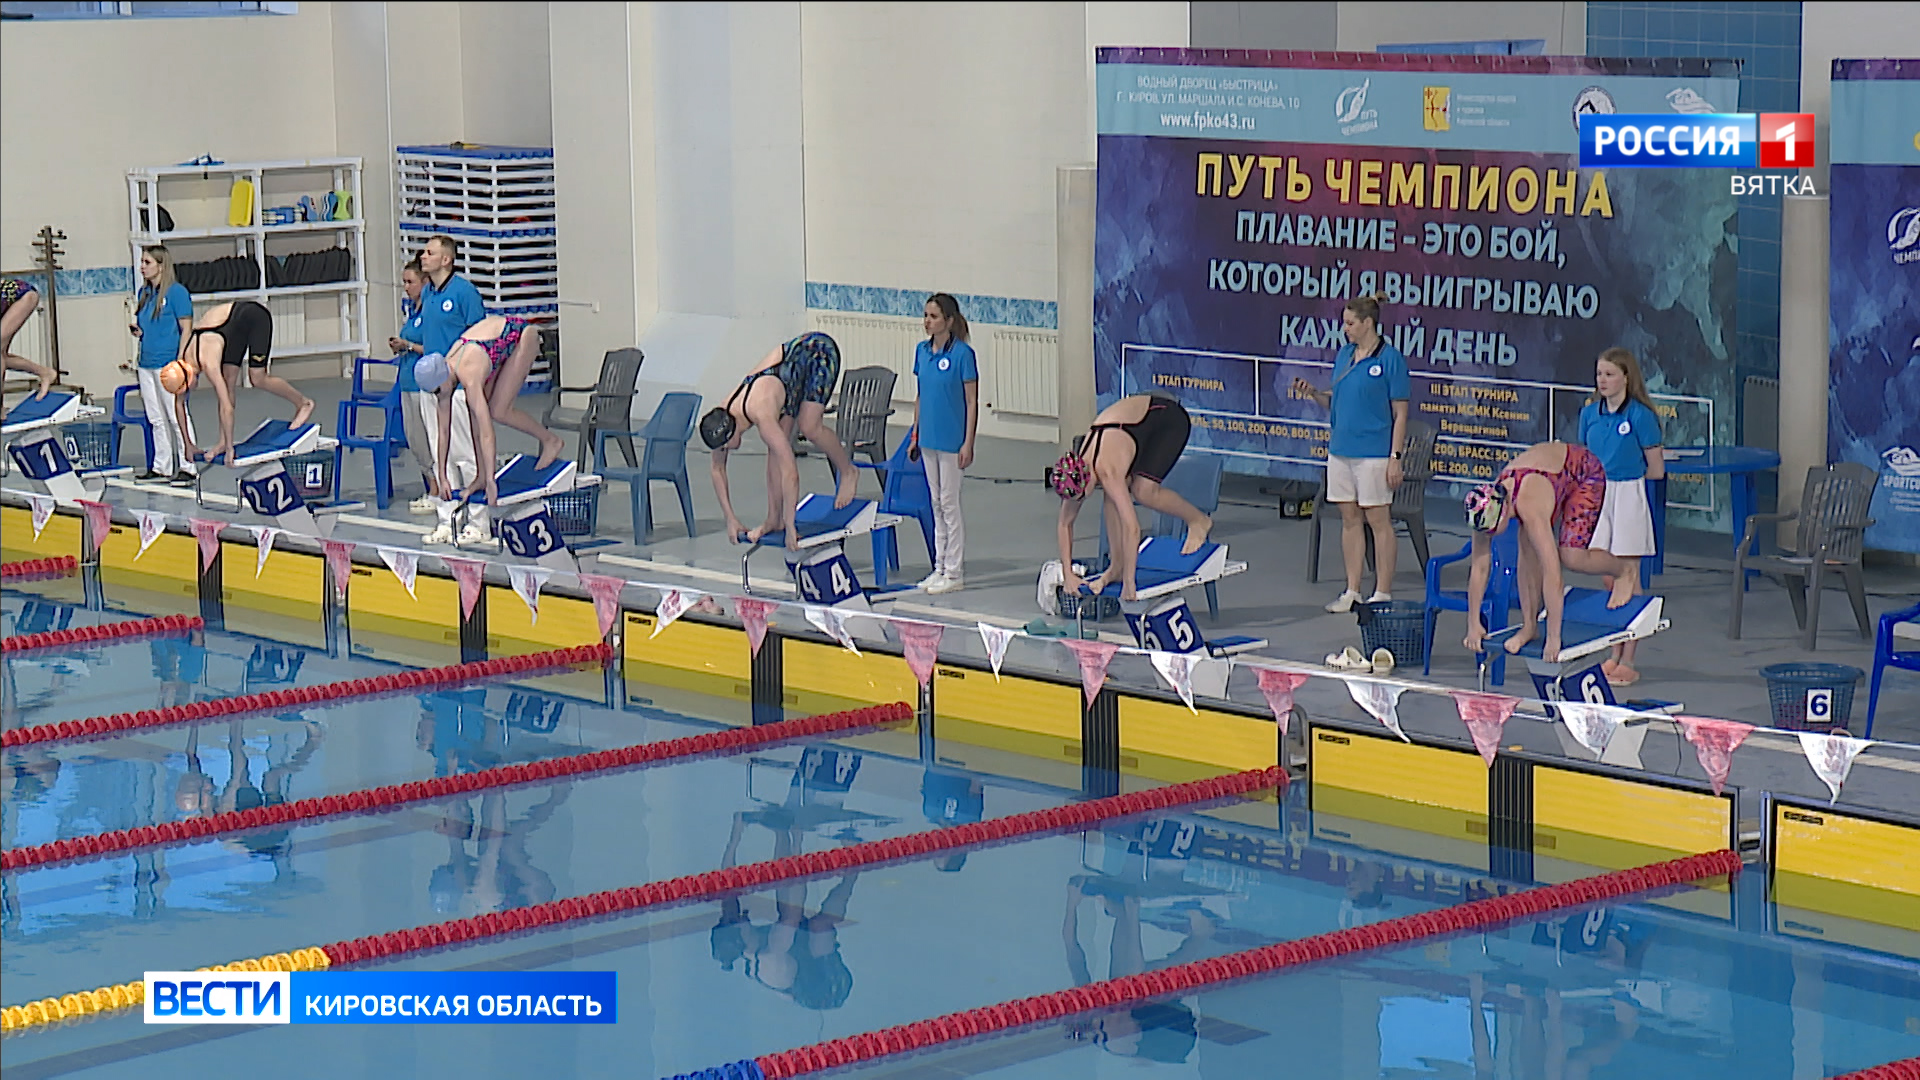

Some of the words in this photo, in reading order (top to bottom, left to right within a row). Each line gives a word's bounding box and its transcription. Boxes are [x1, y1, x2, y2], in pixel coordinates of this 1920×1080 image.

[1137, 75, 1177, 89] ВОДНЫЙ
[1179, 77, 1217, 90] ДВОРЕЦ
[1178, 93, 1227, 106] МАРШАЛА
[1248, 96, 1286, 109] КОНЕВА,
[1288, 97, 1300, 109] 10
[1160, 111, 1256, 131] www.fpko43.ru
[1196, 152, 1312, 201] ПУТЬ
[1324, 158, 1614, 218] ЧЕМПИОНА
[1236, 210, 1397, 252] ПЛАВАНИЕ
[1423, 222, 1482, 258] ЭТО
[1490, 220, 1567, 269] БОЙ,
[1208, 259, 1351, 300] КОТОРЫЙ
[1359, 270, 1378, 298] Я
[1385, 271, 1599, 319] ВЫИГРЫВАЮ
[1281, 315, 1425, 358] КАЖЫЙ
[1430, 327, 1518, 366] ДЕНЬ
[1157, 374, 1181, 388] ЭТАП
[1182, 376, 1225, 392] ТУРНИРА
[1430, 383, 1441, 395] III
[1442, 385, 1469, 398] ЭТАП
[1470, 387, 1519, 402] ТУРНИРА
[1420, 403, 1456, 414] памяти
[1457, 404, 1491, 418] МСМК
[1492, 407, 1530, 421] Ксении
[1212, 419, 1226, 432] 50,
[1227, 421, 1246, 433] 100,
[1247, 423, 1268, 436] 200,
[1269, 426, 1290, 438] 400,
[1314, 430, 1330, 442] 150
[1440, 419, 1508, 438] Верещагиной
[39, 443, 58, 473] 1
[1434, 443, 1456, 458] 200,
[1458, 446, 1493, 460] БРАСС:
[308, 465, 320, 484] 1
[1448, 461, 1471, 476] 200,
[1472, 465, 1492, 477] 400
[246, 485, 269, 514] 2
[267, 480, 292, 508] 2
[504, 525, 526, 555] 3
[529, 518, 553, 553] 3
[801, 569, 821, 601] 4
[831, 561, 852, 596] 4
[1168, 609, 1195, 650] 5
[1581, 673, 1605, 705] 6
[1810, 693, 1829, 716] 6
